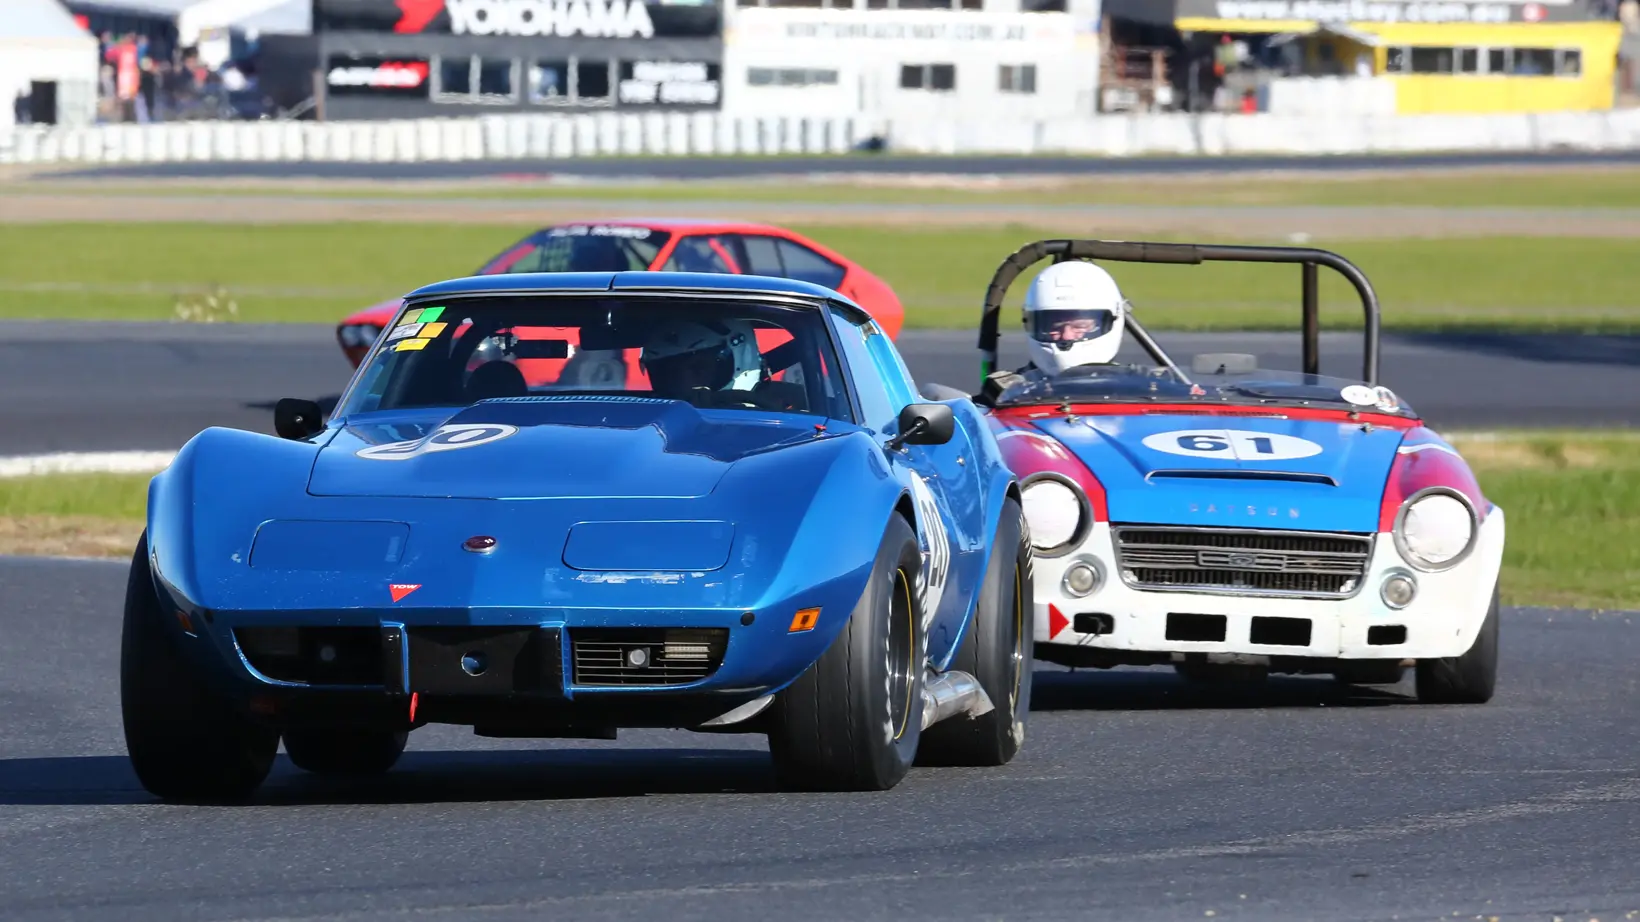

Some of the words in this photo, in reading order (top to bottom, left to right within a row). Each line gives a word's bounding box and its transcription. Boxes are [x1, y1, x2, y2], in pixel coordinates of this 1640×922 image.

[447, 0, 654, 37] YOKOHAMA
[1177, 434, 1274, 454] 61
[1190, 503, 1299, 519] DATSUN
